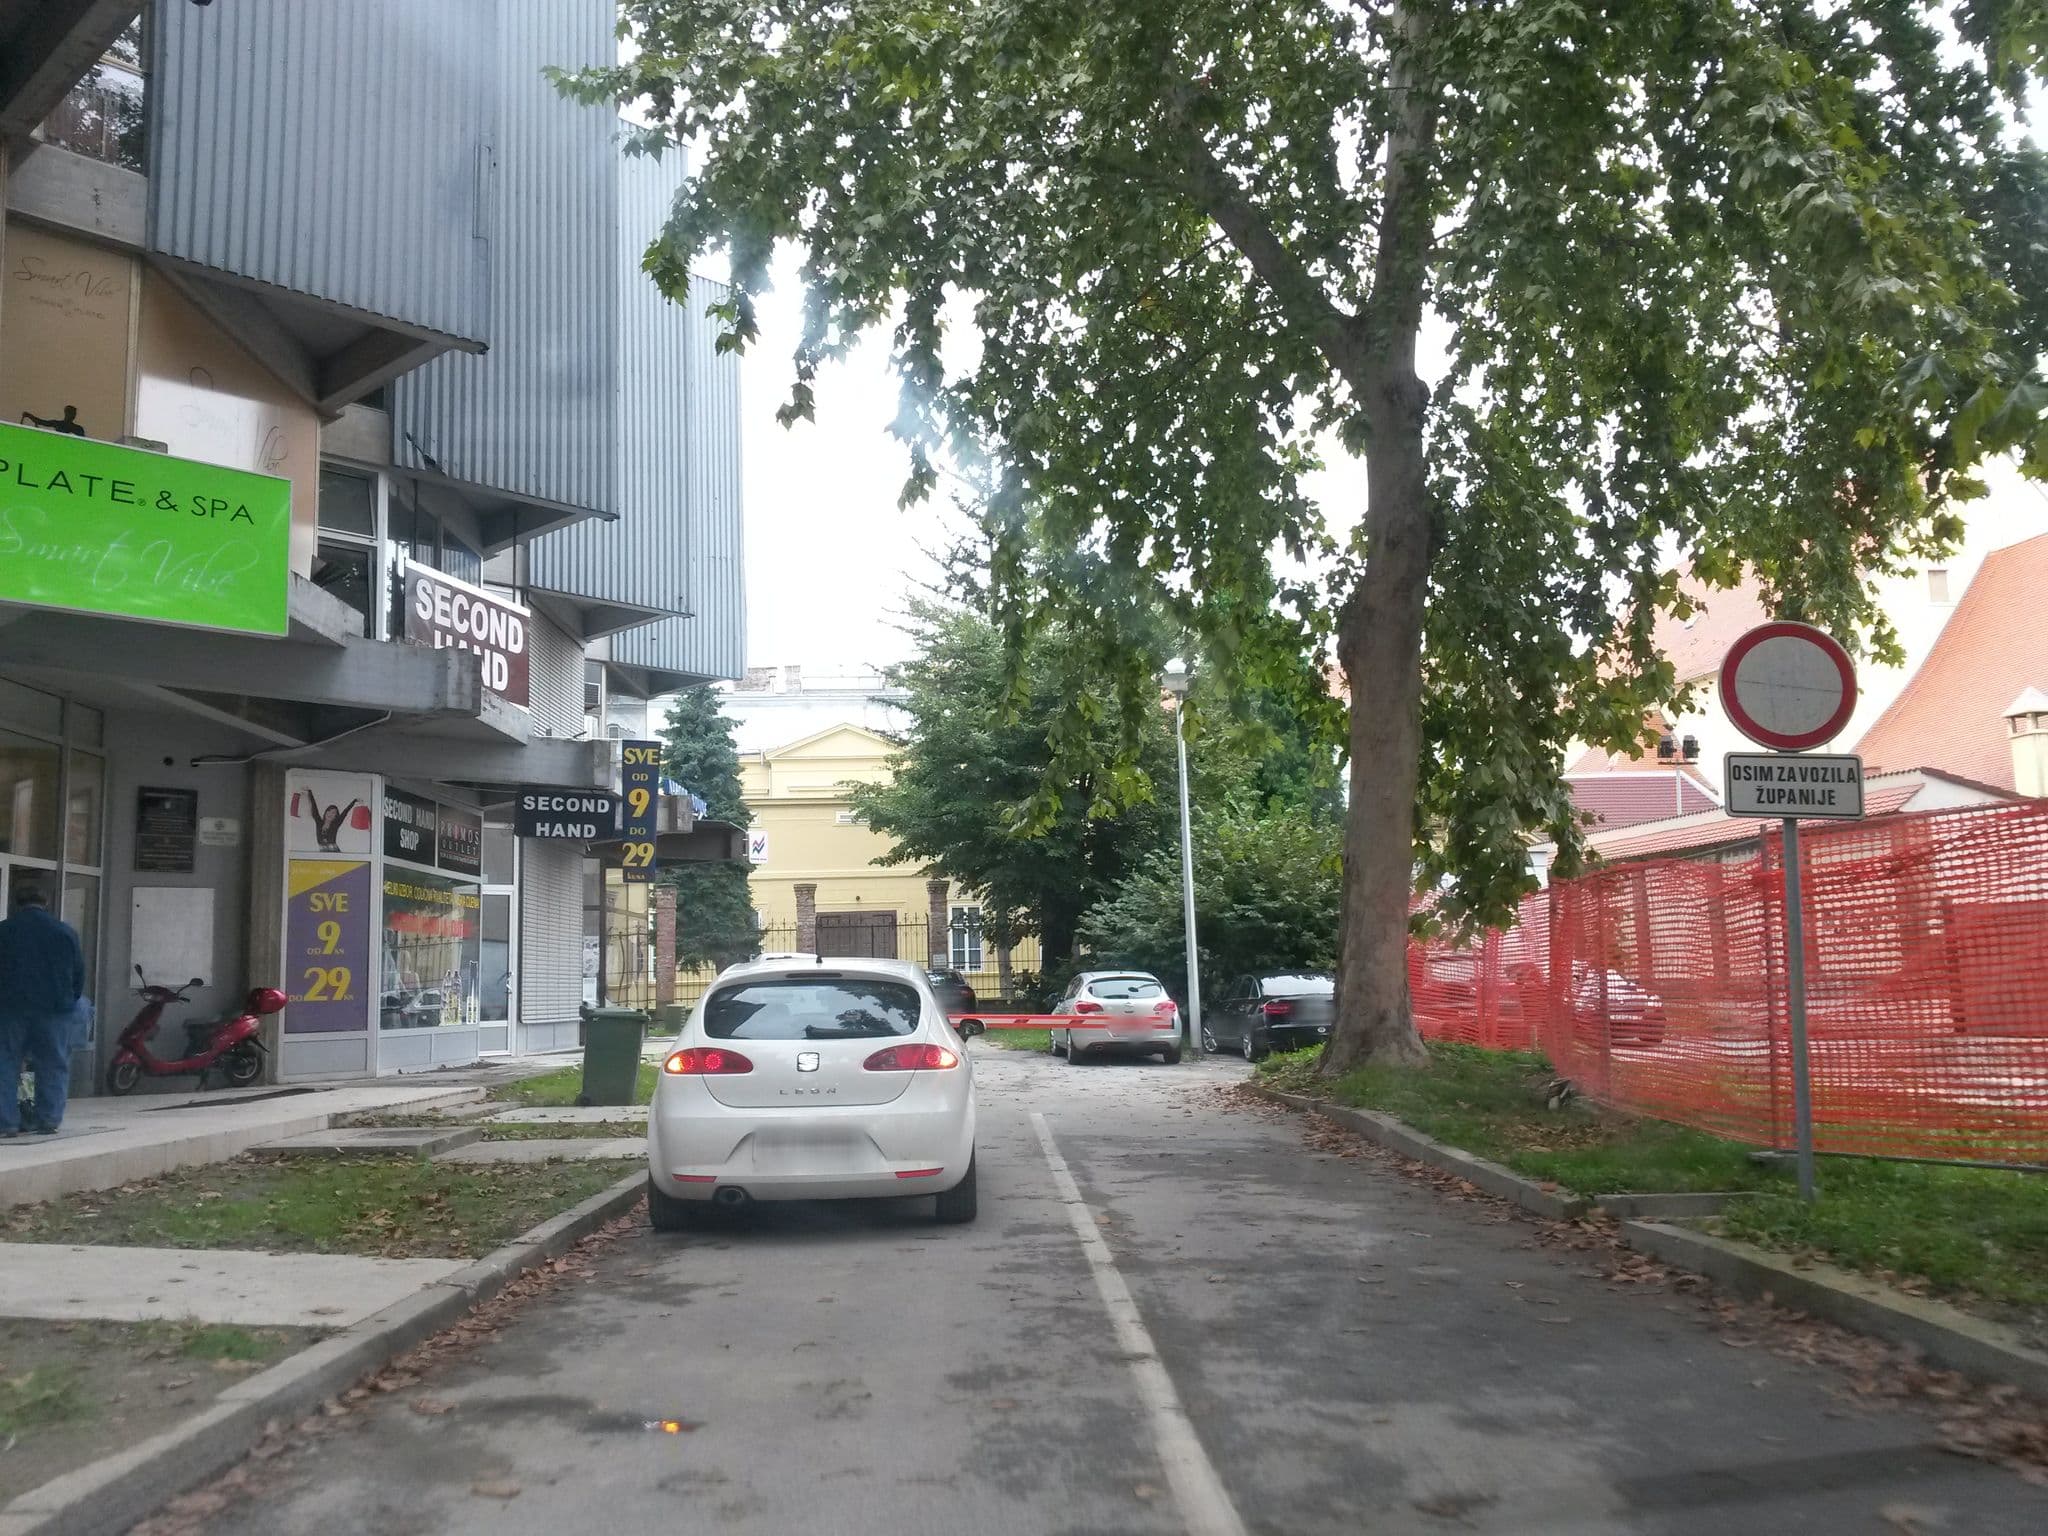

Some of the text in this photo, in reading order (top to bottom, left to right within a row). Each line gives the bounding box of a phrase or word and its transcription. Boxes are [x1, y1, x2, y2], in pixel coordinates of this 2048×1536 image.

[156, 491, 178, 512] &
[191, 496, 254, 525] SPA
[416, 579, 523, 653] SECOND
[624, 748, 659, 765] SVE
[632, 773, 648, 781] OD
[1732, 765, 1773, 781] OSIM
[523, 796, 609, 813] SECOND
[628, 788, 650, 817] 9
[1756, 785, 1836, 805] ŽUPANIJE
[384, 796, 434, 830] SECOND HAND
[400, 828, 419, 850] SHOP
[536, 822, 597, 838] HAND
[629, 827, 646, 835] DO
[622, 842, 655, 867] 29
[310, 892, 349, 912] SVE
[317, 920, 341, 955] 9
[304, 967, 351, 1001] 29
[779, 1087, 837, 1096] LEON
